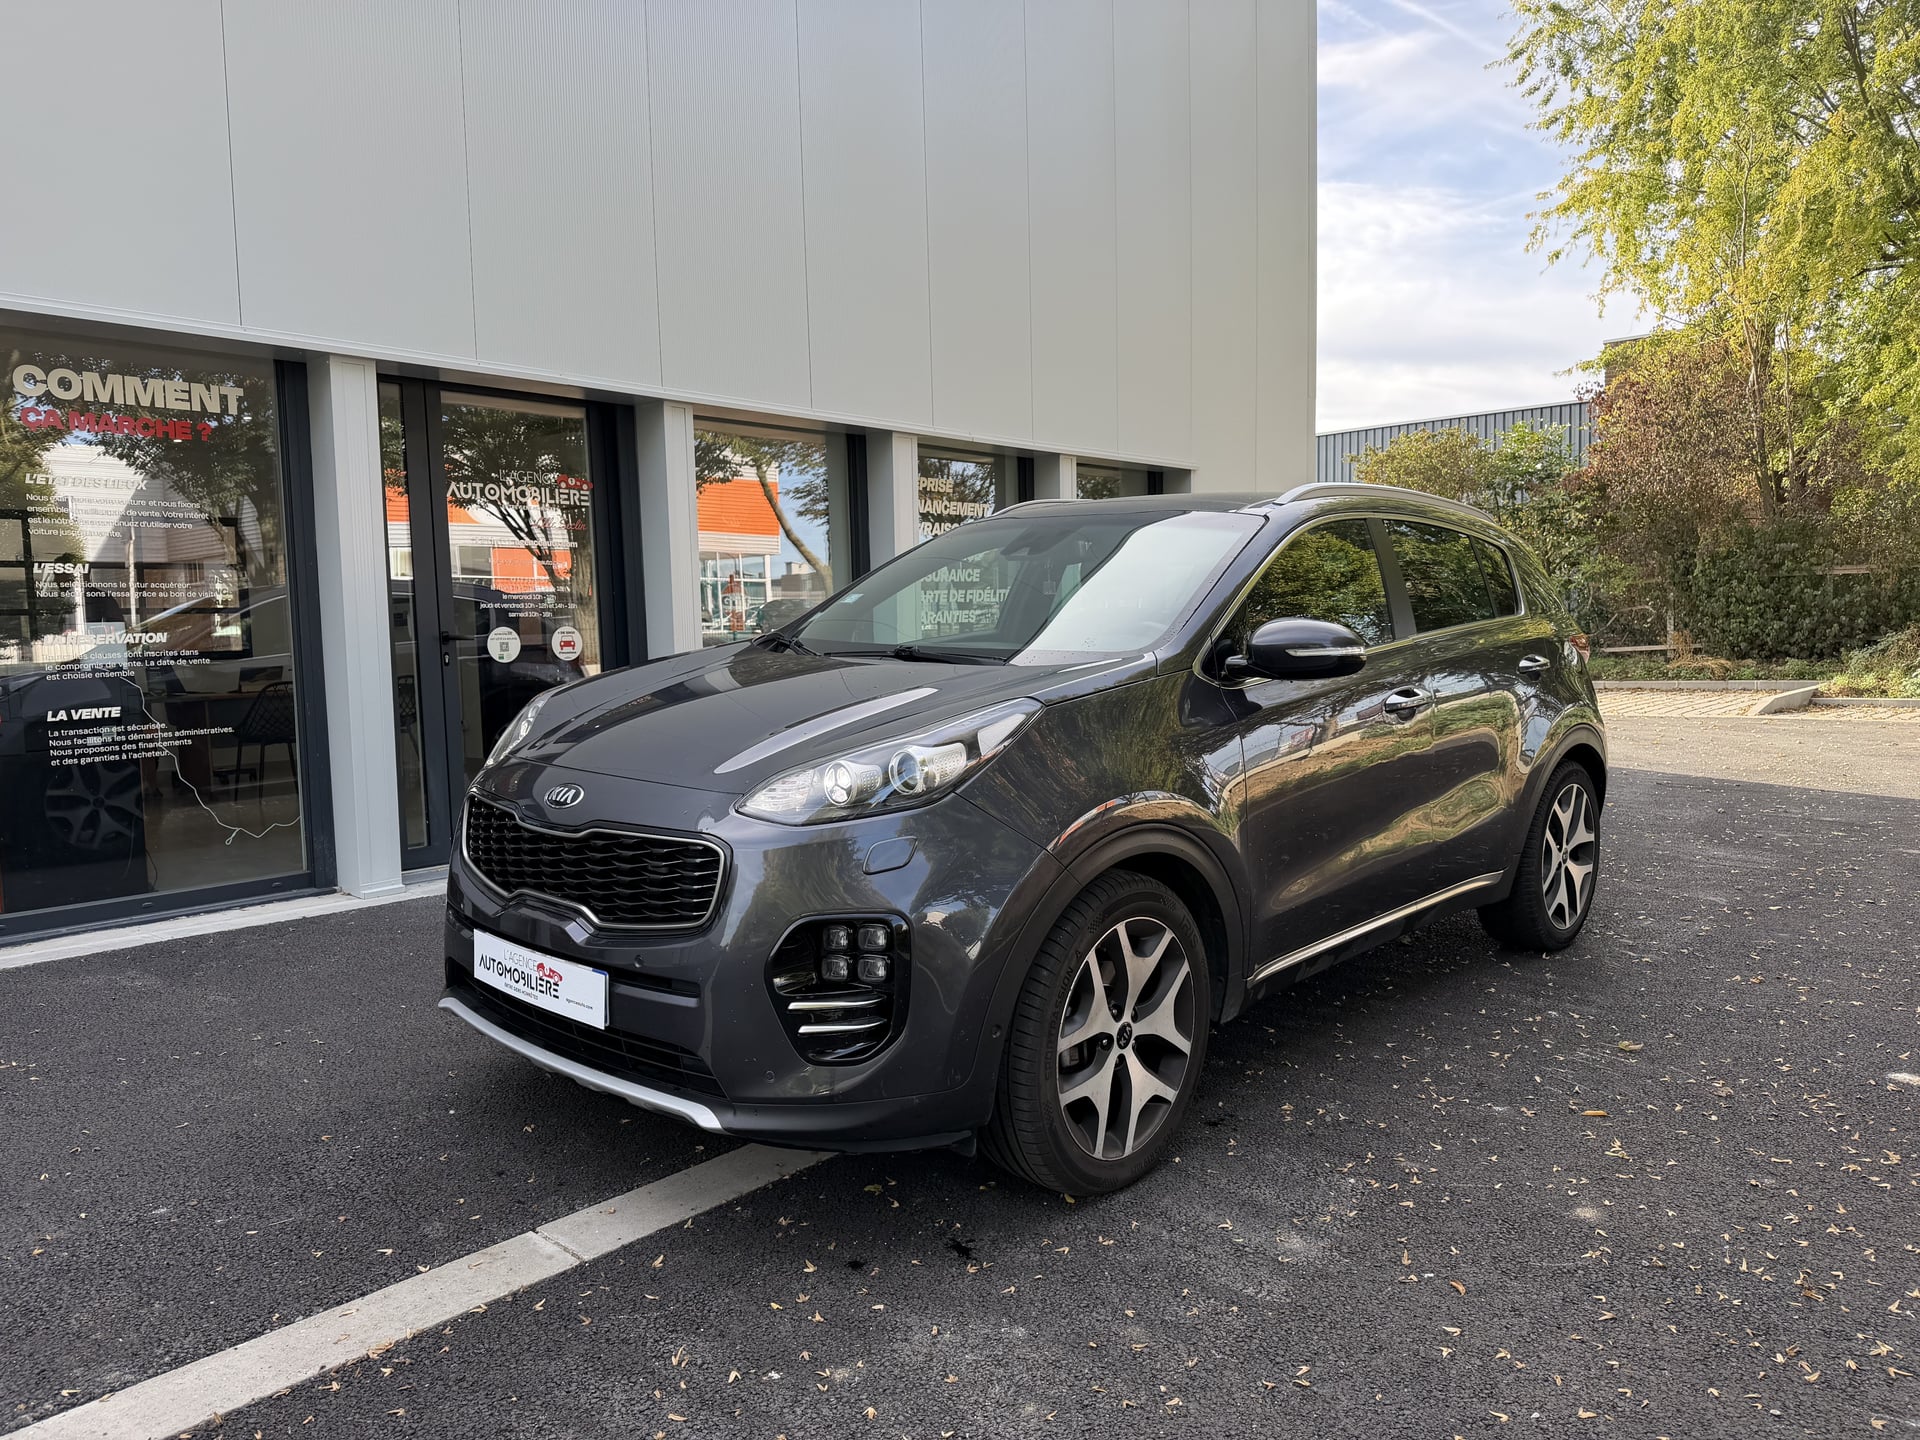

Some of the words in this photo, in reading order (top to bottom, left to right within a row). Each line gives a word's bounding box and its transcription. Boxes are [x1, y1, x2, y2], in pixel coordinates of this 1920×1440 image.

[12, 364, 244, 415] COMMENT
[20, 406, 64, 432] ÇA
[68, 410, 192, 440] MARCHE
[197, 422, 212, 442] ?
[26, 493, 49, 502] Nous
[158, 500, 177, 508] nous
[26, 505, 69, 514] ensemble
[162, 510, 184, 519] Votre
[27, 528, 59, 536] voiture
[172, 522, 193, 530] votre
[33, 562, 90, 574] L'ESSAI
[35, 580, 58, 588] Nous
[129, 581, 149, 589] utur
[36, 590, 59, 598] Nous
[60, 589, 106, 598] sécsons
[107, 590, 132, 598] l'essa
[170, 590, 185, 598] bon
[186, 590, 197, 598] de
[949, 589, 965, 603] DE
[143, 649, 179, 657] inscrites
[179, 648, 200, 657] dans
[45, 663, 53, 671] le
[144, 659, 155, 667] La
[156, 658, 175, 666] date
[176, 657, 187, 666] de
[188, 657, 211, 666] vente
[46, 673, 61, 681] est
[62, 671, 93, 680] choisie
[95, 669, 135, 678] ensemble
[46, 709, 68, 722] LA
[70, 706, 122, 721] VENTE
[47, 729, 59, 738] La
[61, 726, 110, 737] transaction
[111, 725, 126, 733] est
[48, 739, 72, 747] Nous
[73, 735, 113, 745] facilitons
[113, 734, 126, 742] les
[127, 731, 173, 741] démarches
[174, 726, 235, 737] administratives.
[49, 749, 73, 757] Nous
[74, 744, 120, 757] proposons
[121, 742, 137, 751] des
[138, 738, 193, 750] financements
[50, 759, 61, 767] et
[62, 757, 79, 766] des
[80, 754, 120, 766] garanties
[548, 786, 577, 804] KIA
[503, 948, 538, 973] L'AGENCE
[479, 953, 560, 1000] AUTOMOBILIERE
